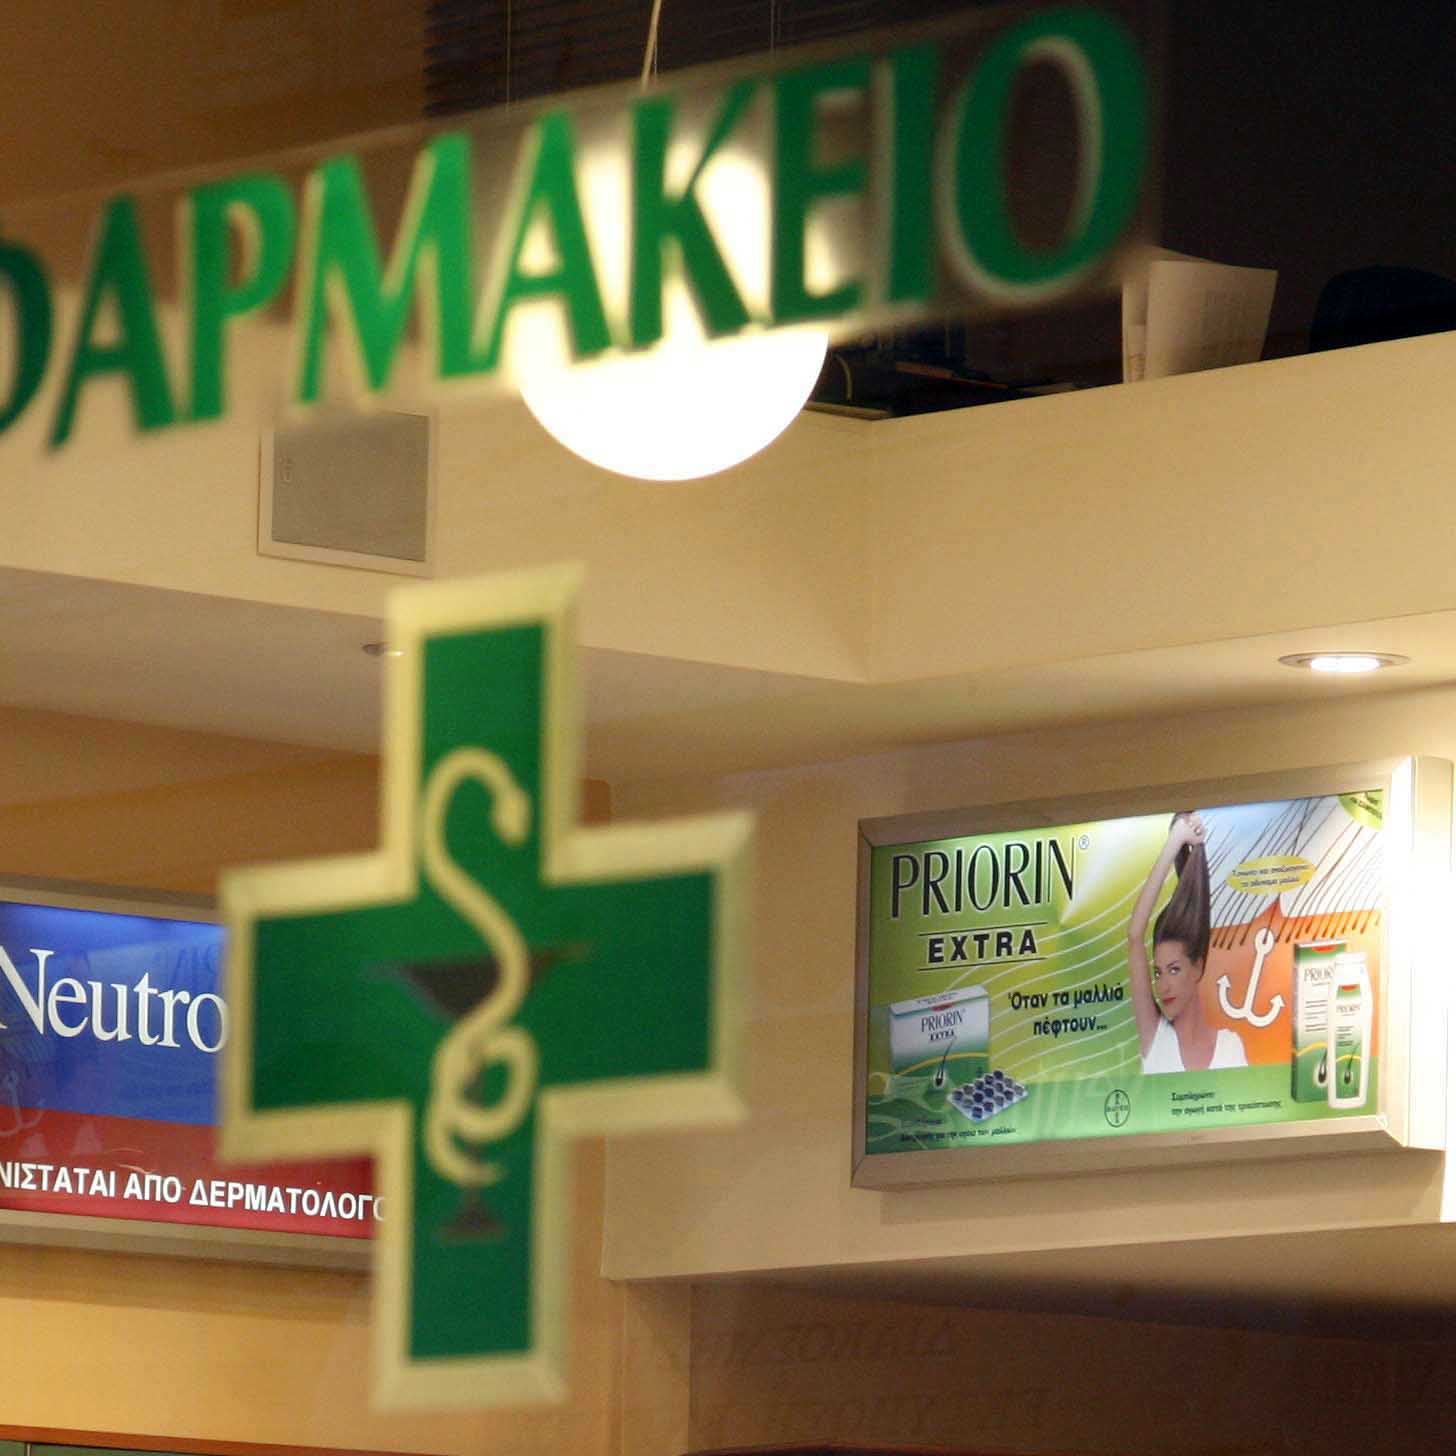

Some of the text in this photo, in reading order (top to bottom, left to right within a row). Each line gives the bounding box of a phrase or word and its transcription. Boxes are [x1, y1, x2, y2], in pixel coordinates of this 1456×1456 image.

[891, 838, 1076, 918] PRIORIN
[927, 929, 1038, 964] EXTRA
[1052, 992, 1070, 1006] τα
[123, 1173, 182, 1203] ΑΠΟ
[189, 1179, 385, 1222] ΔΕΡΜΑΤΟΛΟΓΟ
